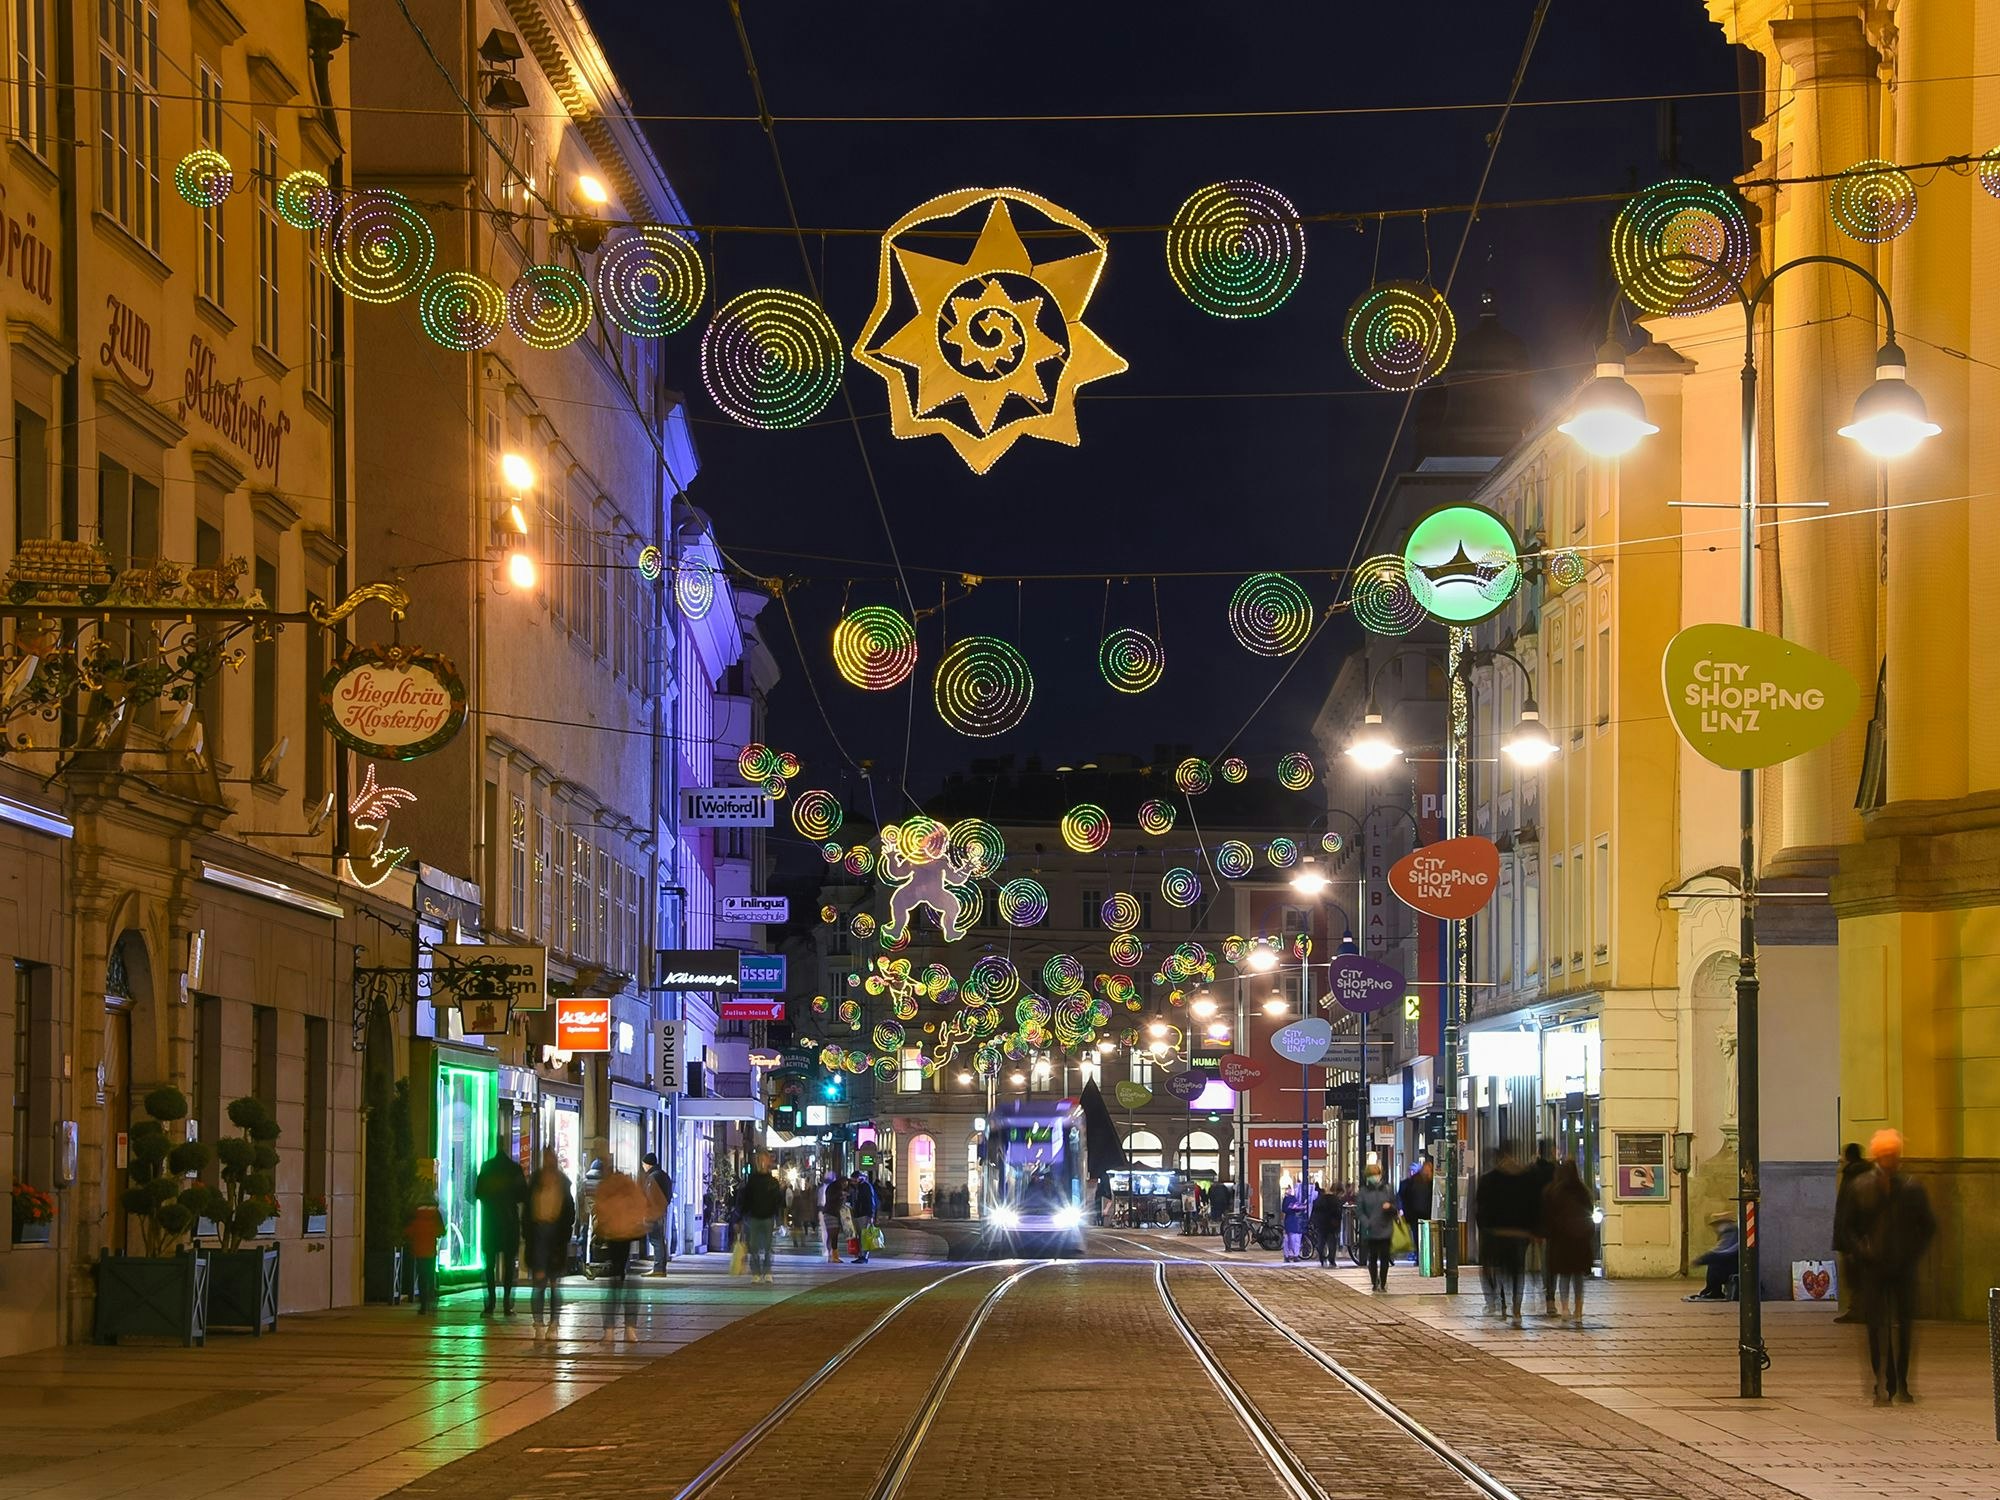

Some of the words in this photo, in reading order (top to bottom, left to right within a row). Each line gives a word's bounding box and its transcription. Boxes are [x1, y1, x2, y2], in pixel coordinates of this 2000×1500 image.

[0, 184, 52, 306] räu
[341, 671, 444, 708] Stieglbräu
[343, 705, 449, 737] Klosterhof
[702, 798, 753, 814] Wolford
[741, 898, 785, 910] inlingua
[726, 911, 785, 922] Sprachschule
[741, 966, 781, 981] össer
[663, 1025, 678, 1087] pimkie
[785, 1061, 809, 1069] ACHTEN
